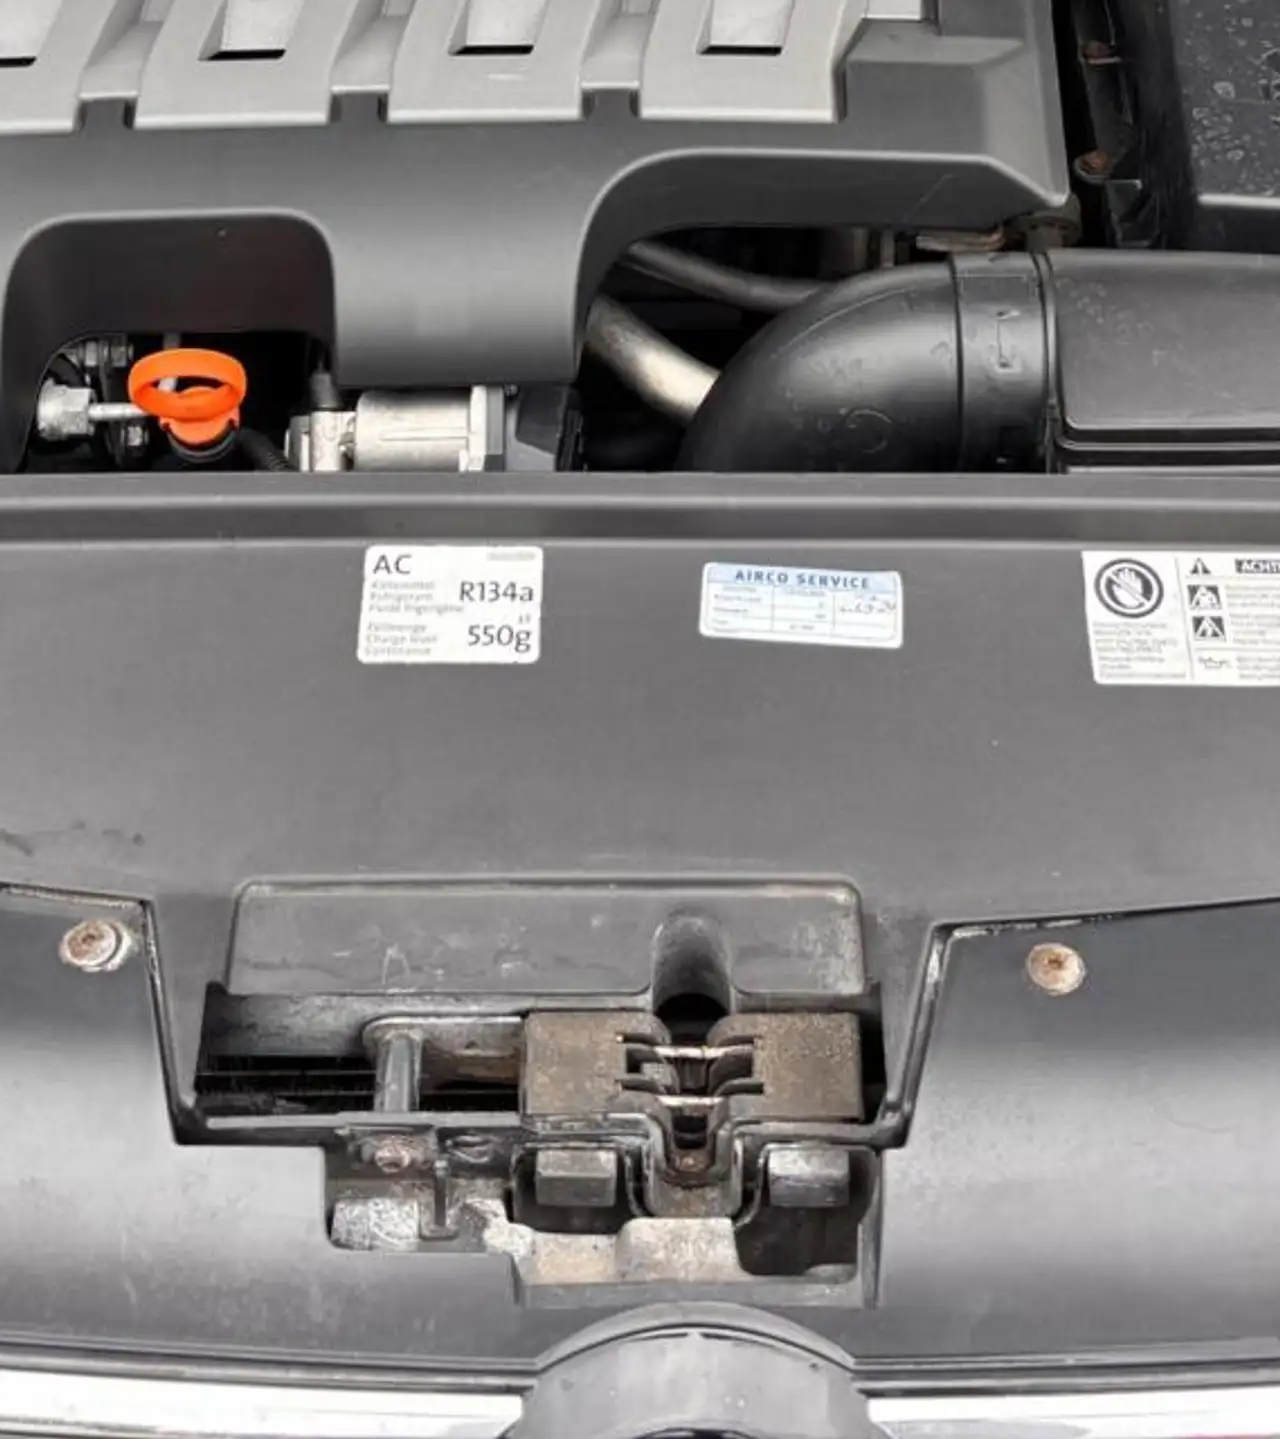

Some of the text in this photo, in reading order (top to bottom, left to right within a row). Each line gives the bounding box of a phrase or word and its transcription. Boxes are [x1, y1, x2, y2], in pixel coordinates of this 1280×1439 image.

[372, 554, 412, 575] AC
[735, 569, 870, 589] AIRCO SERVICE
[459, 581, 534, 602] R134a
[467, 624, 532, 654] 550g
